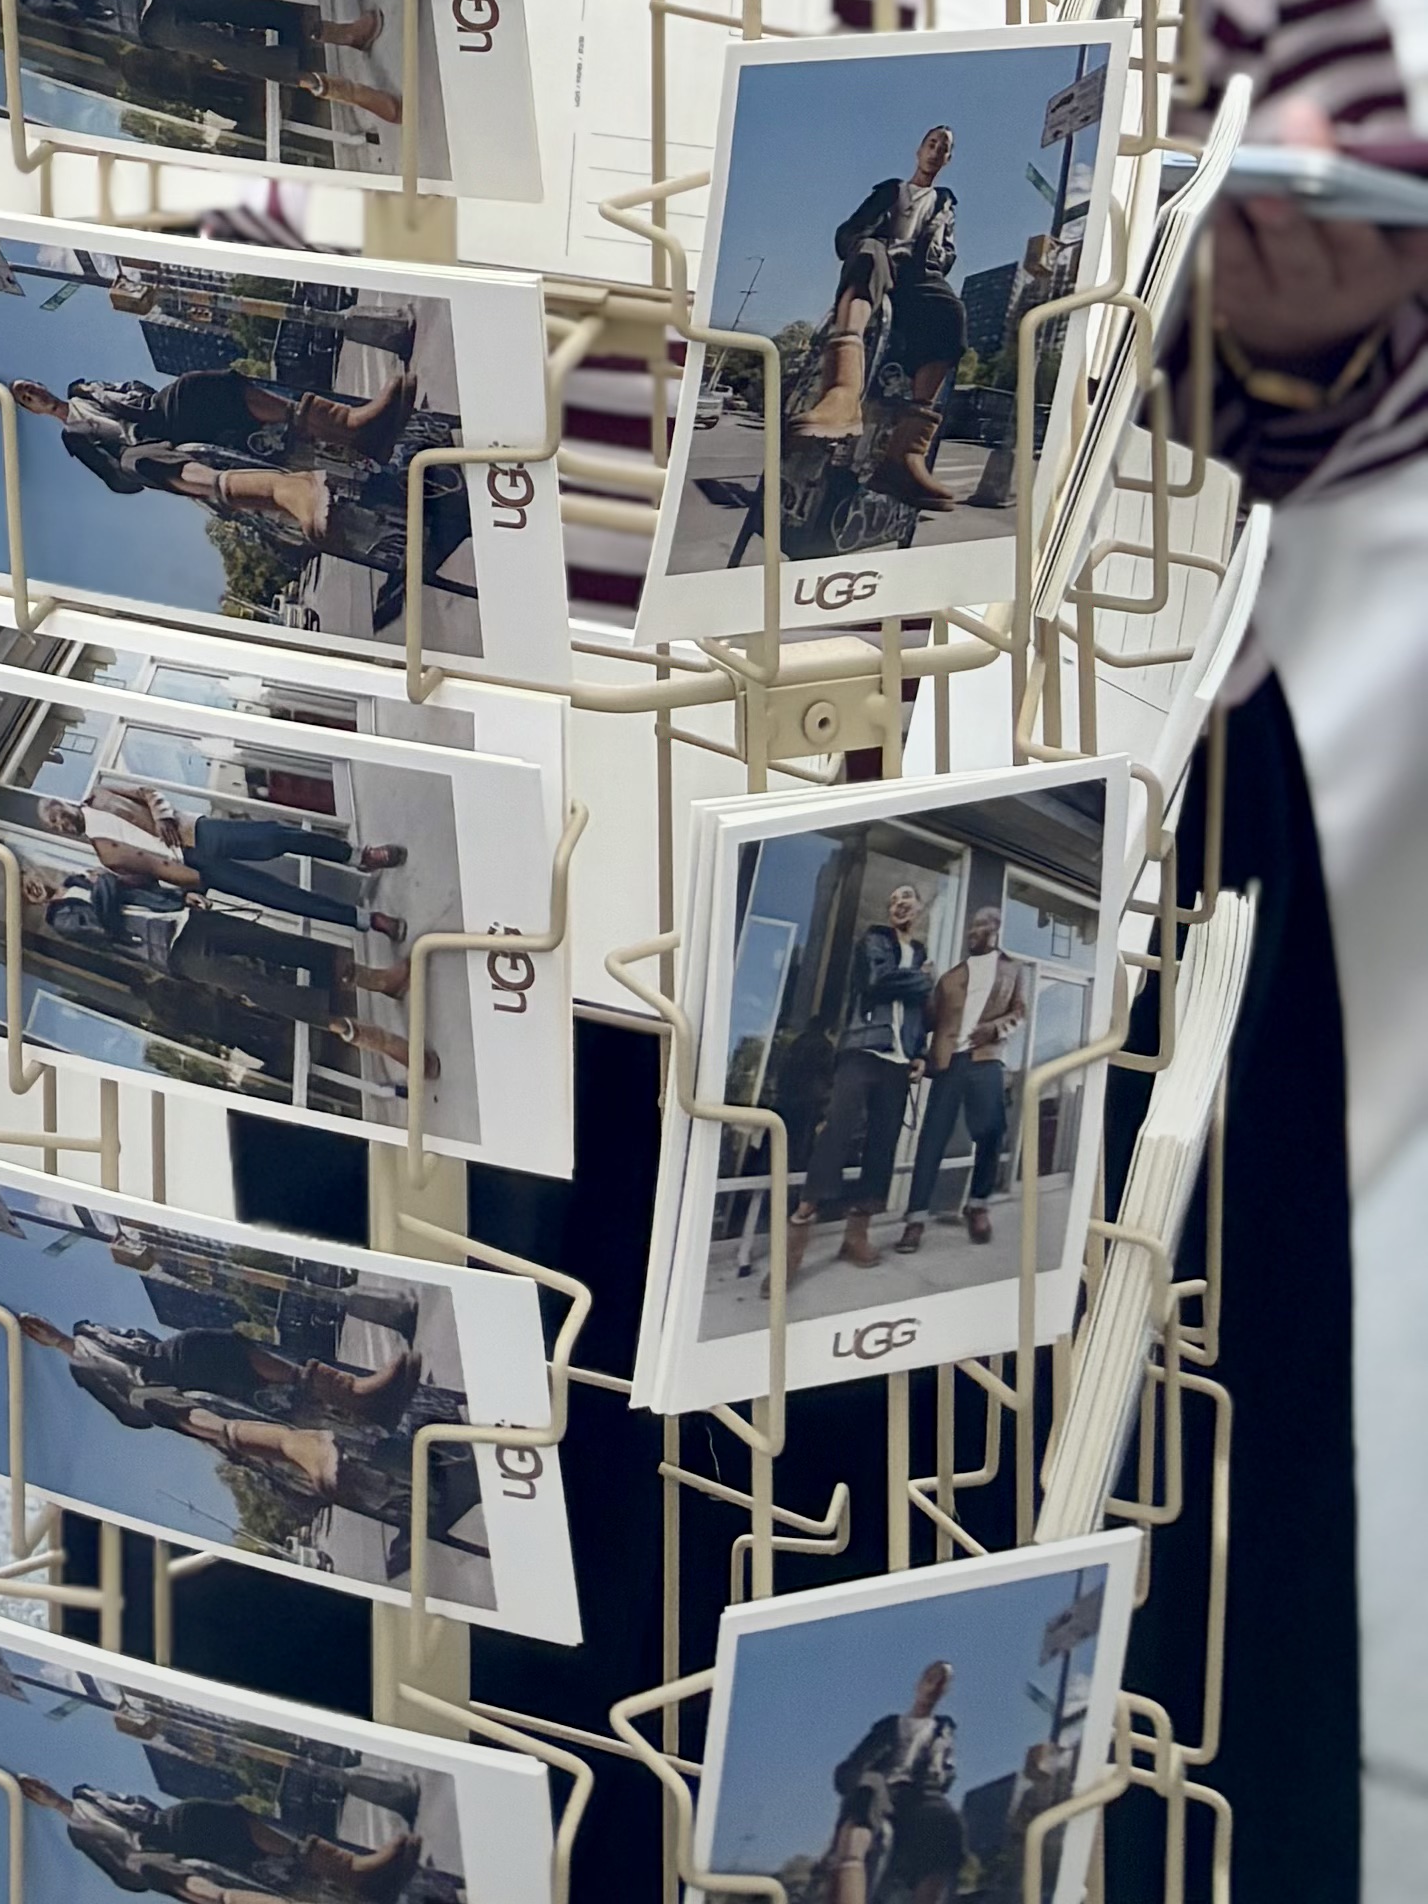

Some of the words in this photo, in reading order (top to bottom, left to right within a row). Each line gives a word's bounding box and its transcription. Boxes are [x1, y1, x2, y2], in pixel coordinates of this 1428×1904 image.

[794, 571, 880, 610] UGG
[833, 1318, 918, 1360] UGG
[495, 1422, 543, 1500] UG
